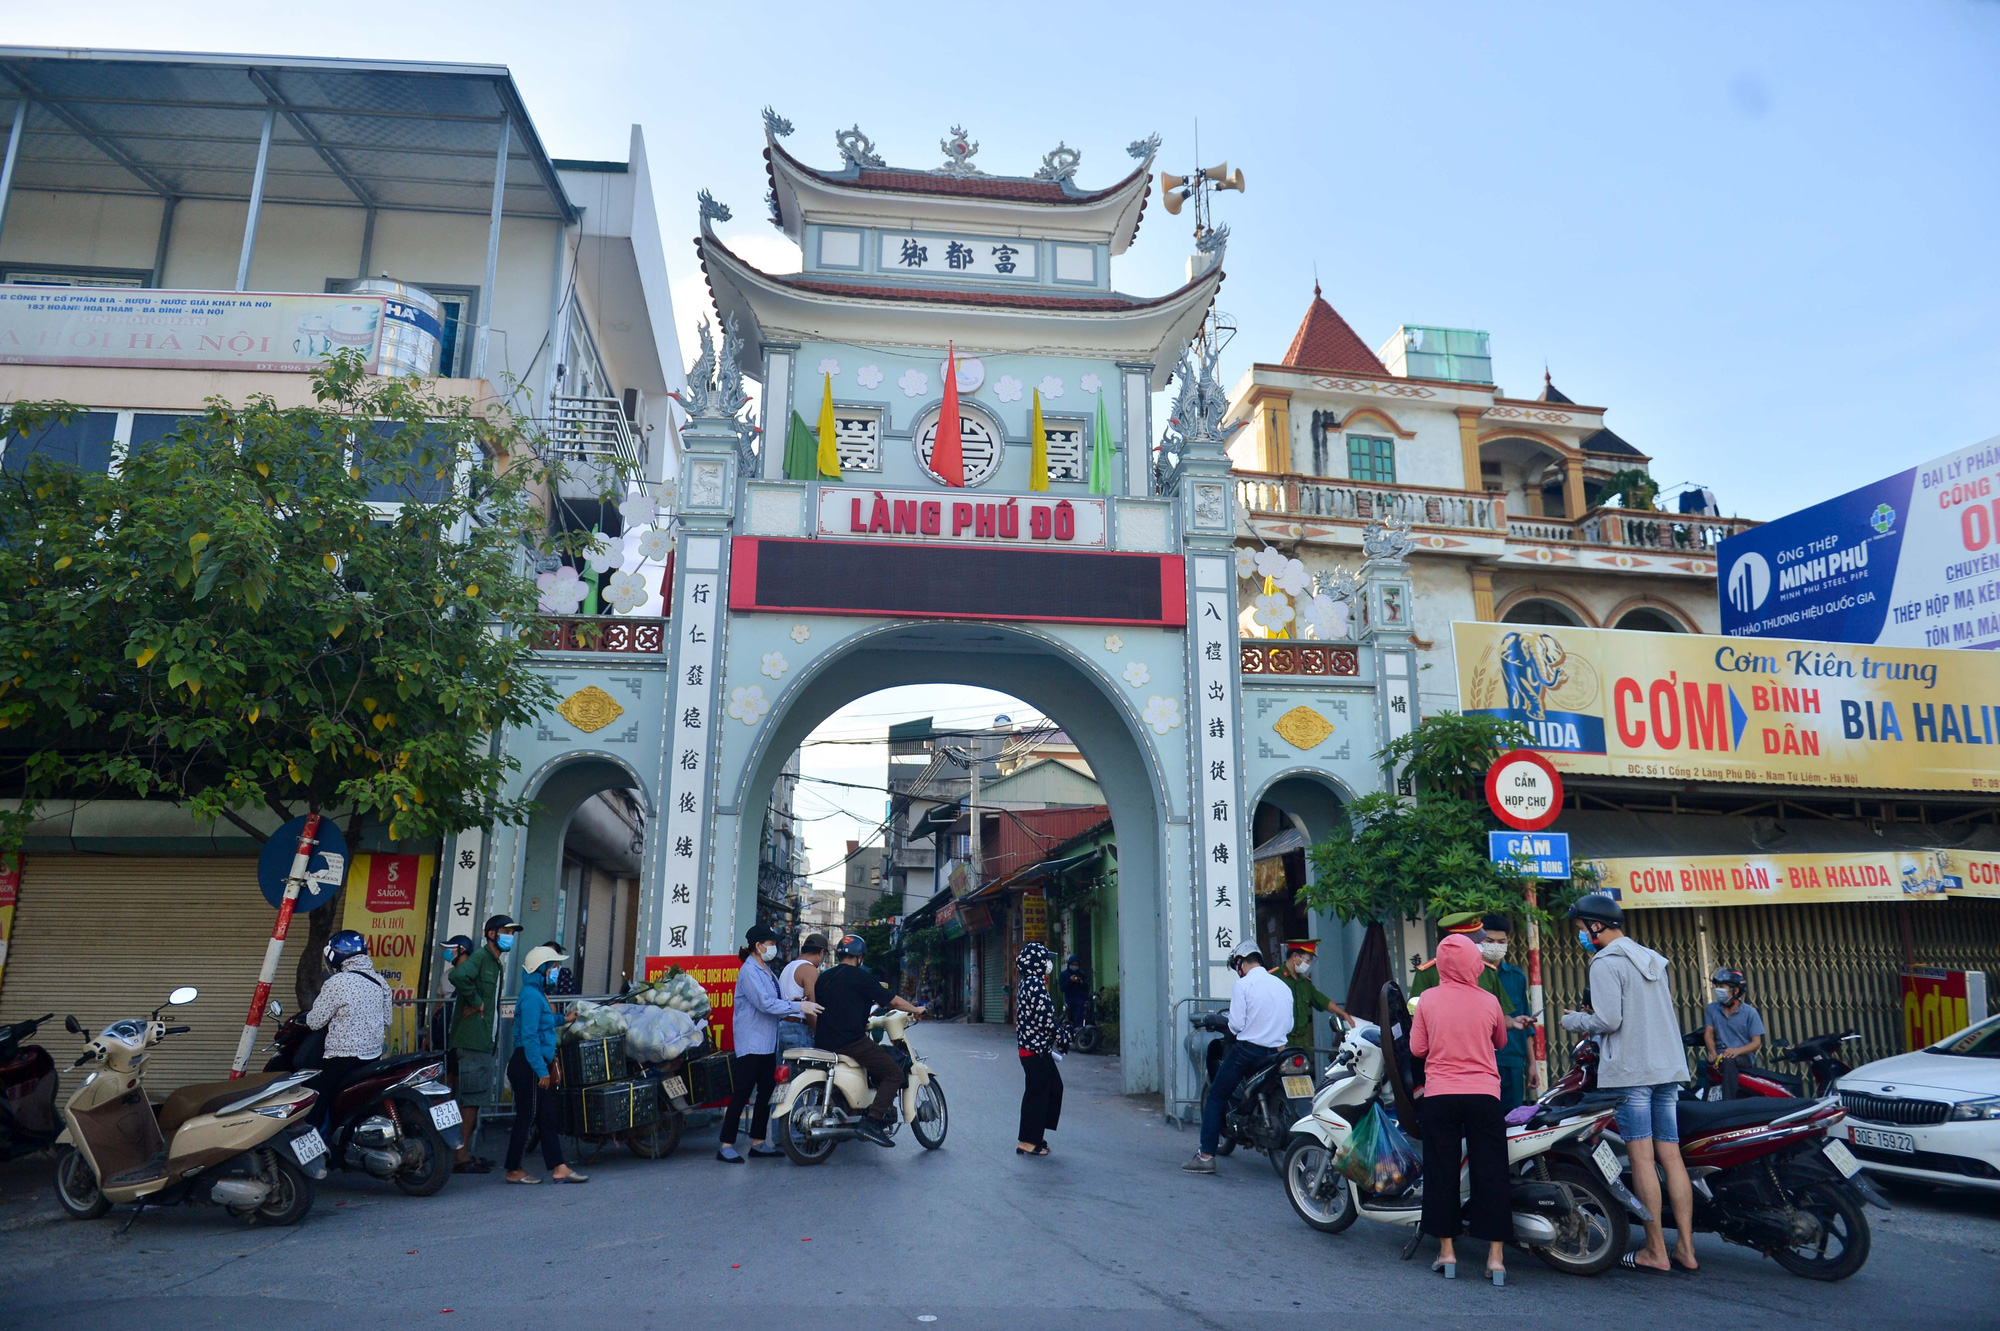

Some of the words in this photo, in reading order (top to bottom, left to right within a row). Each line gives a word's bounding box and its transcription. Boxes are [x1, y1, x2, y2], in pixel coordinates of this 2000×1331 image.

[127, 329, 183, 350] HÀ
[196, 330, 273, 357] NỘI
[1922, 467, 1944, 490] ĐẠI
[1947, 456, 1962, 481] LÝ
[1939, 477, 1992, 510] CÔNG
[850, 490, 941, 536] LÀNG
[952, 497, 1018, 539] PHÚ
[1030, 498, 1074, 541] ĐÔ
[1808, 534, 1838, 554] THÉP
[1779, 556, 1828, 592] MINH
[1780, 590, 1801, 602] MINH
[1804, 584, 1820, 597] PHU
[1822, 577, 1848, 590] STEEL
[1850, 569, 1869, 582] PIPE
[1762, 610, 1800, 631] THƯƠNG
[1801, 605, 1824, 621] HIỆU
[1825, 594, 1855, 614] QUỐC
[1856, 591, 1876, 605] GIA
[1893, 600, 1922, 624] THÉP
[1926, 594, 1950, 618] HỘP
[1954, 588, 1976, 610] MẠ
[1925, 625, 1950, 648] TÔN
[1953, 620, 1975, 643] MẠ
[1714, 646, 1781, 674] Cơm
[1786, 650, 1858, 678] Kiên
[1862, 656, 1938, 690] trung
[1613, 670, 1730, 752] CƠM
[1751, 680, 1821, 714] BÌNH
[1840, 699, 1904, 742] BIA
[1762, 724, 1820, 756] DÂN
[1628, 764, 1644, 774] ĐC:
[1646, 764, 1658, 775] Số
[1661, 766, 1665, 775] 1
[1694, 767, 1700, 776] 2
[1702, 768, 1724, 780] Làng
[1726, 768, 1742, 779] Phú
[1745, 770, 1756, 780] Đô
[1766, 771, 1785, 782] Nam
[1788, 771, 1799, 782] Từ
[1801, 772, 1822, 782] Liêm
[1830, 773, 1842, 783] Hà
[1844, 774, 1858, 784] Nội
[1505, 795, 1524, 808] HỌP
[1527, 796, 1546, 810] CHỢ
[1541, 860, 1563, 874] RONG
[1630, 867, 1675, 894] CƠM
[1679, 864, 1726, 892] BÌNH
[1730, 862, 1770, 890] DÂN
[1788, 866, 1822, 889] BIA
[1824, 865, 1892, 888] HALIDA
[377, 888, 406, 898] SAIGON
[360, 934, 416, 958] AIGON
[721, 989, 733, 1008] ĐÔ
[1855, 1129, 1912, 1152] 30E-159.22
